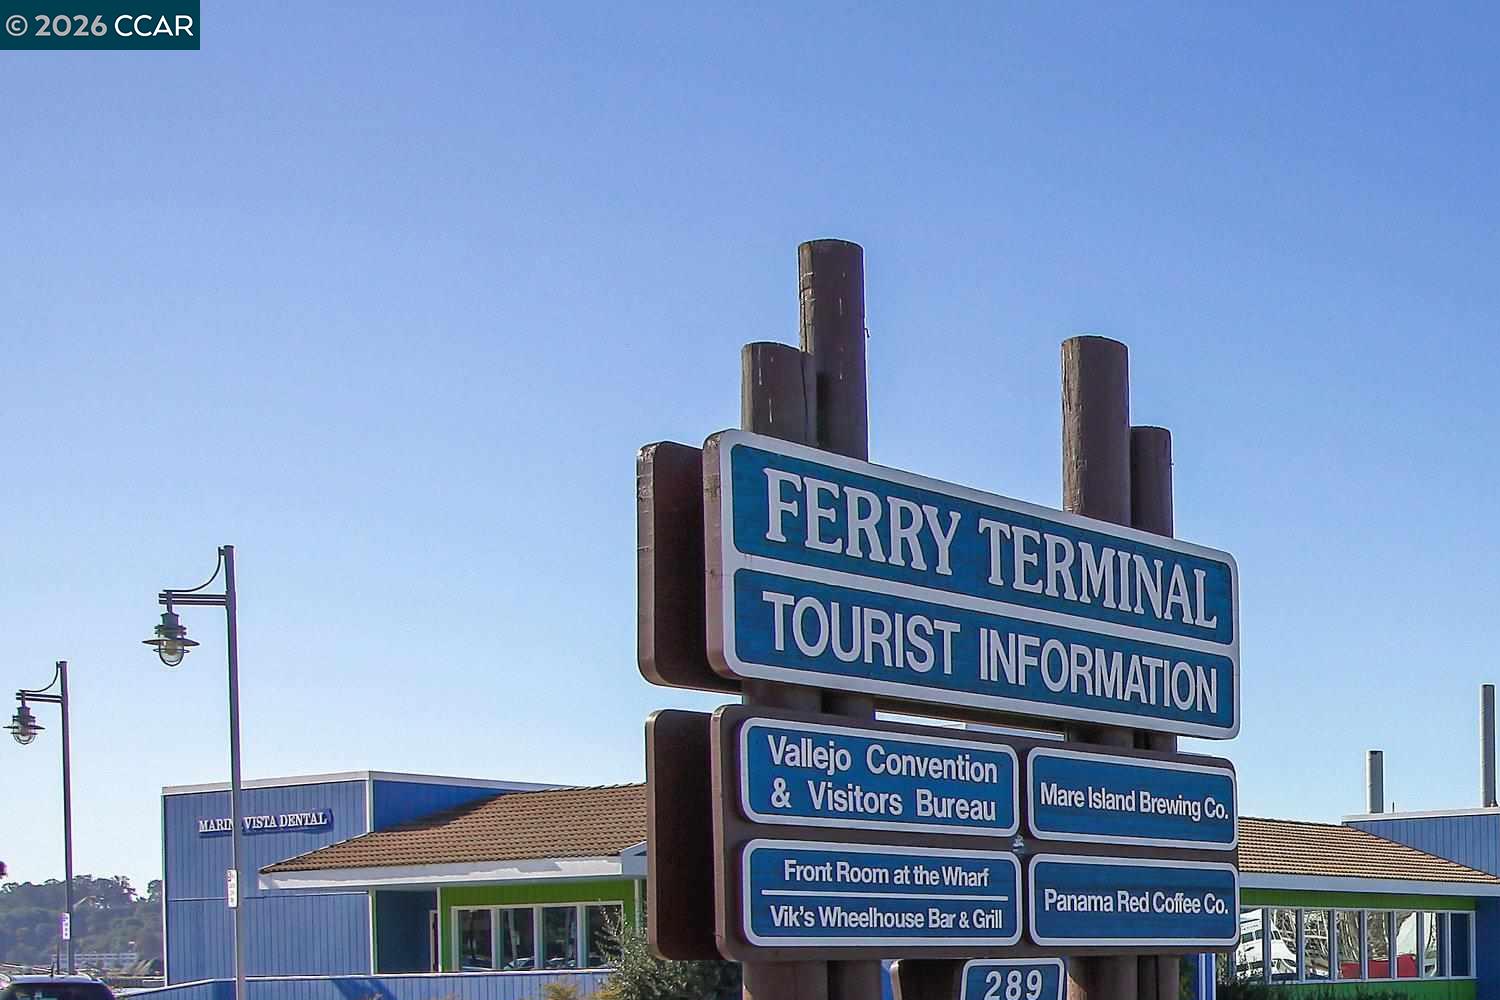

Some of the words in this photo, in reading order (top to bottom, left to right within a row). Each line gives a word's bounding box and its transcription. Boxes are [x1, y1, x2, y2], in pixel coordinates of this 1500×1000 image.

[762, 467, 962, 576] FERRY
[978, 518, 1218, 631] TERMINAL
[762, 591, 961, 675] TOURIST
[980, 627, 1218, 714] INFORMATION
[767, 735, 852, 776] Vallejo
[866, 744, 998, 785] Convention
[771, 778, 792, 809] &
[807, 780, 904, 816] Visitors
[916, 788, 996, 822] Bureau
[1040, 781, 1085, 808] Mare
[1087, 785, 1136, 812] Island
[1139, 789, 1202, 822] Brewing
[1204, 796, 1229, 821] Co.
[199, 818, 235, 832] MARIN
[243, 815, 277, 829] VISTA
[280, 812, 328, 827] DENTAL
[783, 860, 834, 885] Front
[836, 861, 889, 886] Room
[892, 866, 910, 886] at
[913, 865, 938, 887] the
[941, 866, 990, 888] Wharf
[770, 905, 815, 929] Vik's
[818, 905, 925, 930] Wheelhouse
[928, 908, 955, 930] Bar
[958, 911, 970, 930] &
[972, 908, 1003, 931] Grill
[1044, 888, 1114, 913] Panama
[1116, 890, 1149, 914] Red
[1151, 892, 1202, 915] Coffee
[1204, 895, 1229, 916] Co.
